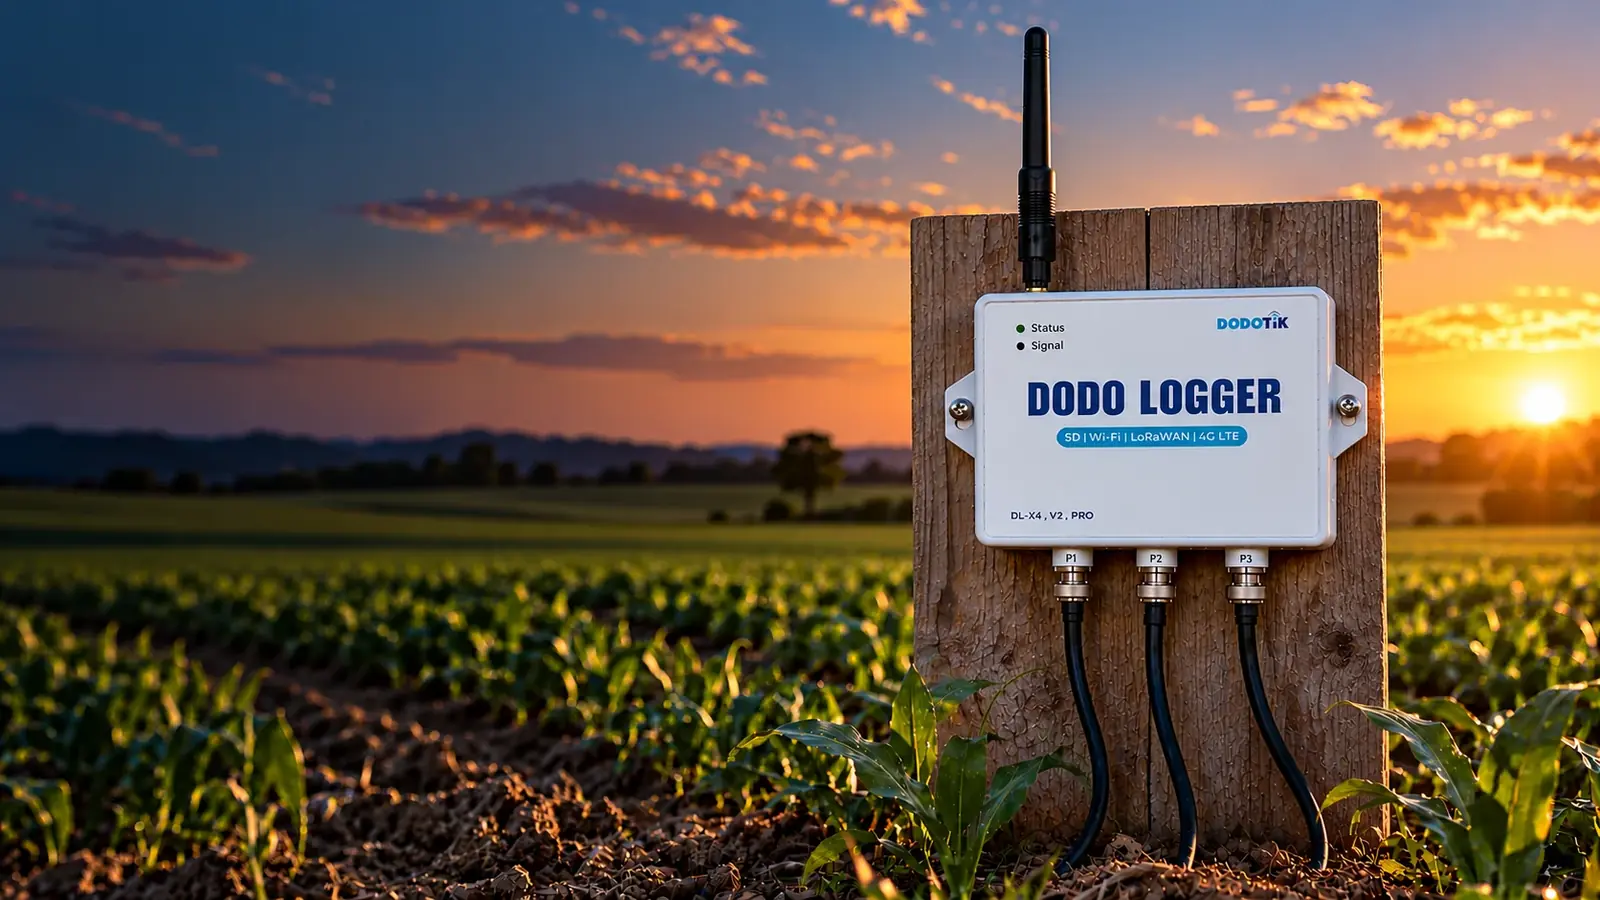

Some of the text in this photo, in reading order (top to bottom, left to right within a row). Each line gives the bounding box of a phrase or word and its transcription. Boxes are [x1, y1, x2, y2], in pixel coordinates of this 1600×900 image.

[1031, 323, 1065, 333] Status
[1031, 340, 1064, 352] Signal
[1027, 378, 1282, 416] DODO LOGGER
[1064, 432, 1081, 442] SD
[1089, 432, 1121, 442] Wi-Fi
[1130, 431, 1190, 442] LoRaWAN
[1198, 431, 1215, 441] 4G
[1218, 431, 1239, 441] LTE
[1010, 511, 1042, 520] DL-X4
[1071, 511, 1094, 520] PRO
[1065, 553, 1077, 563] P1
[1150, 554, 1162, 564] P2
[1240, 554, 1252, 564] P3
